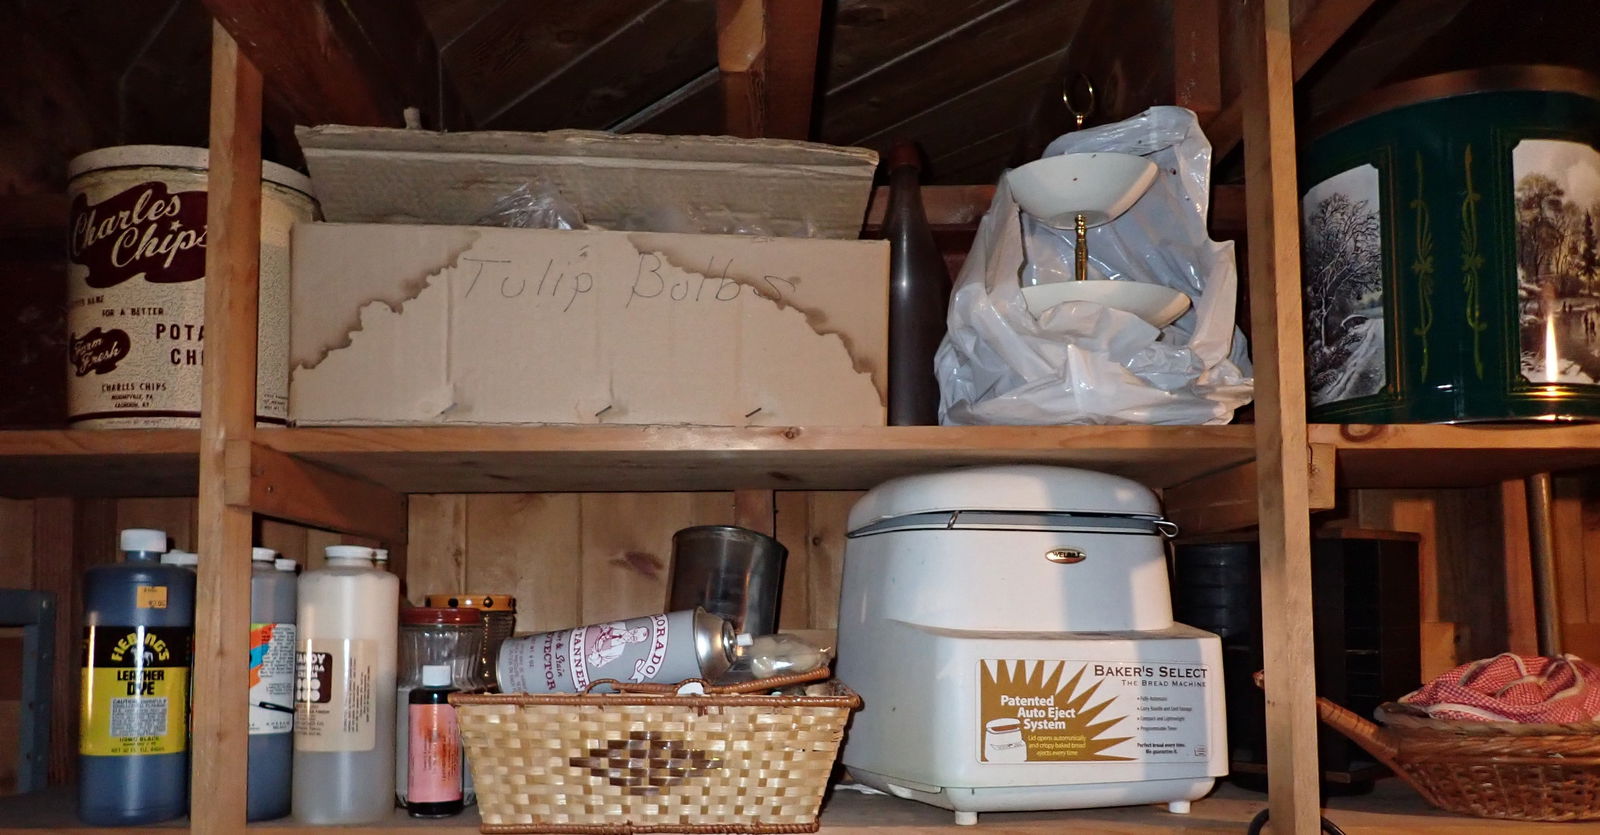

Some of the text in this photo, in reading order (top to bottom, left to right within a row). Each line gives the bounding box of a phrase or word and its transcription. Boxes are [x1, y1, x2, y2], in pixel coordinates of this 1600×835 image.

[73, 189, 181, 257] Charles
[463, 252, 796, 312] Tulip Bulbs
[102, 308, 114, 317] FOR
[131, 307, 164, 316] BETTER
[79, 340, 121, 374] Fresh
[101, 382, 167, 392] CHARLES CHIPS
[555, 653, 566, 678] Stain
[573, 632, 587, 689] TANNER
[1094, 664, 1207, 679] BAKER'S SELECT
[1000, 694, 1054, 706] Patented
[1017, 707, 1076, 720] Auto Eject
[1023, 718, 1066, 732] System
